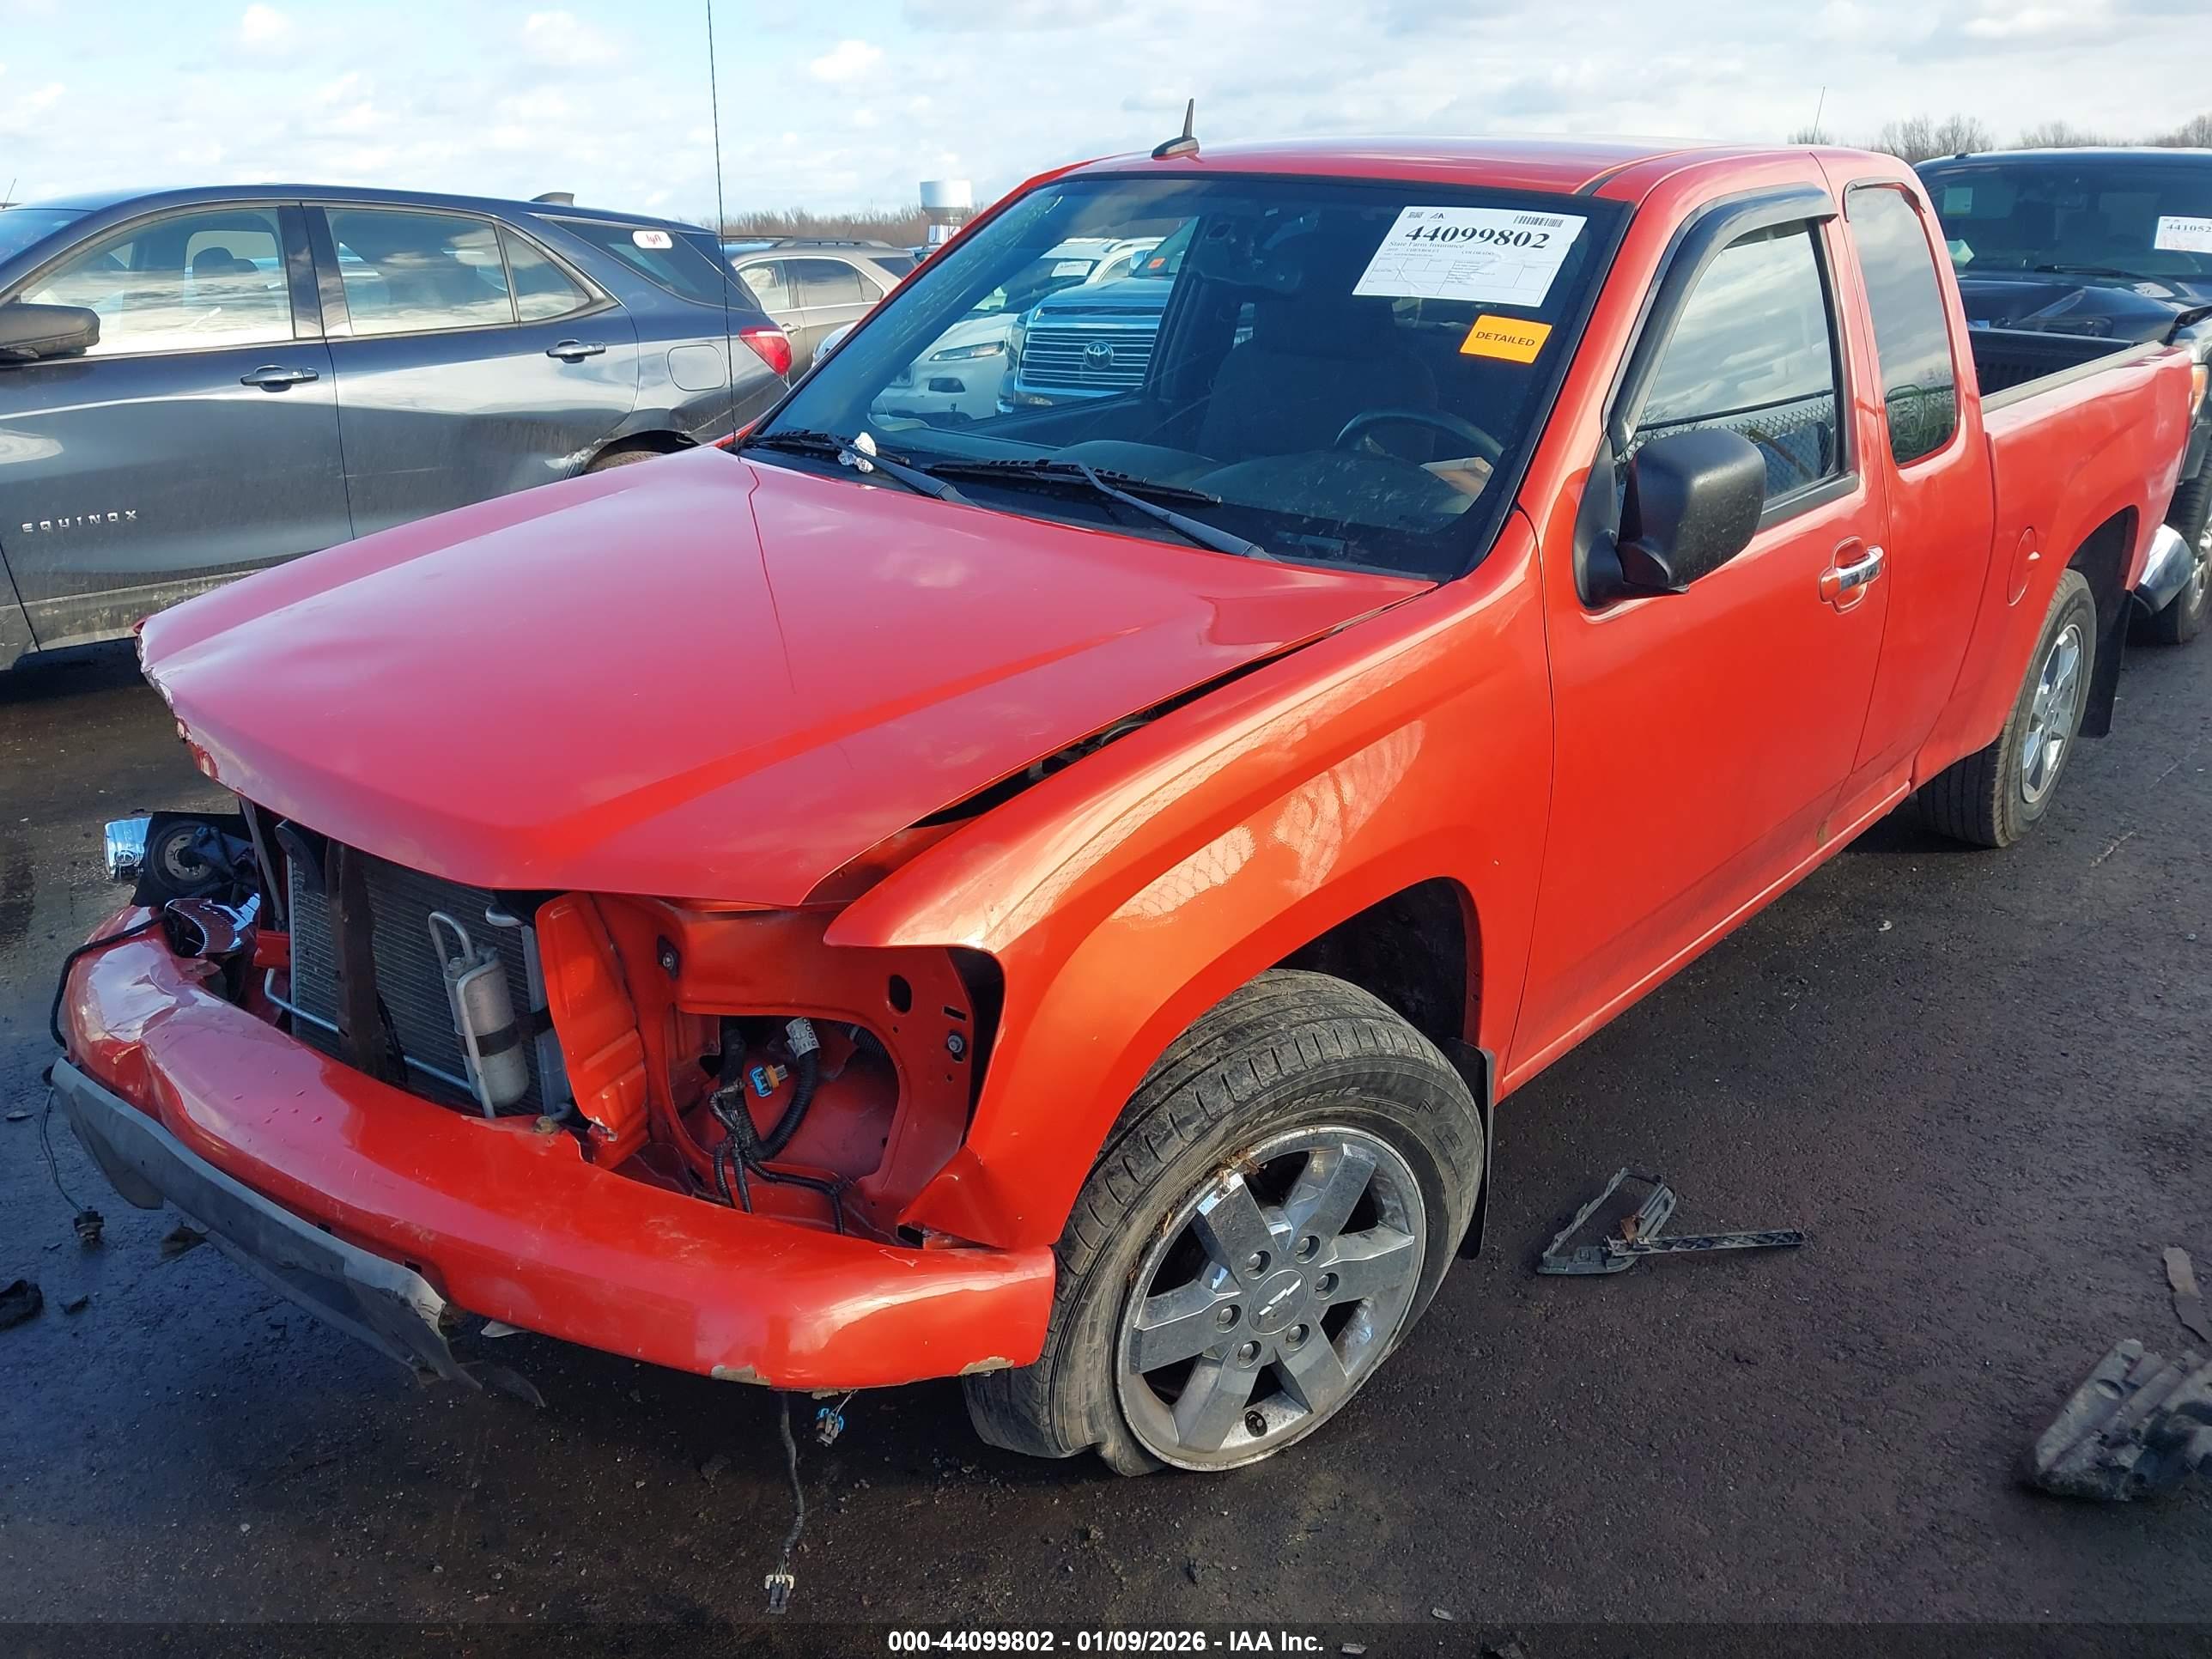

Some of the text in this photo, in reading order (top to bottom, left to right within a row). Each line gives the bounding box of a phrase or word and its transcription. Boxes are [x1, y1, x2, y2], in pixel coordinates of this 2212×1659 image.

[1405, 226, 1550, 249] 44099802
[1475, 331, 1535, 347] DETAILED
[21, 510, 137, 533] EQUINOX
